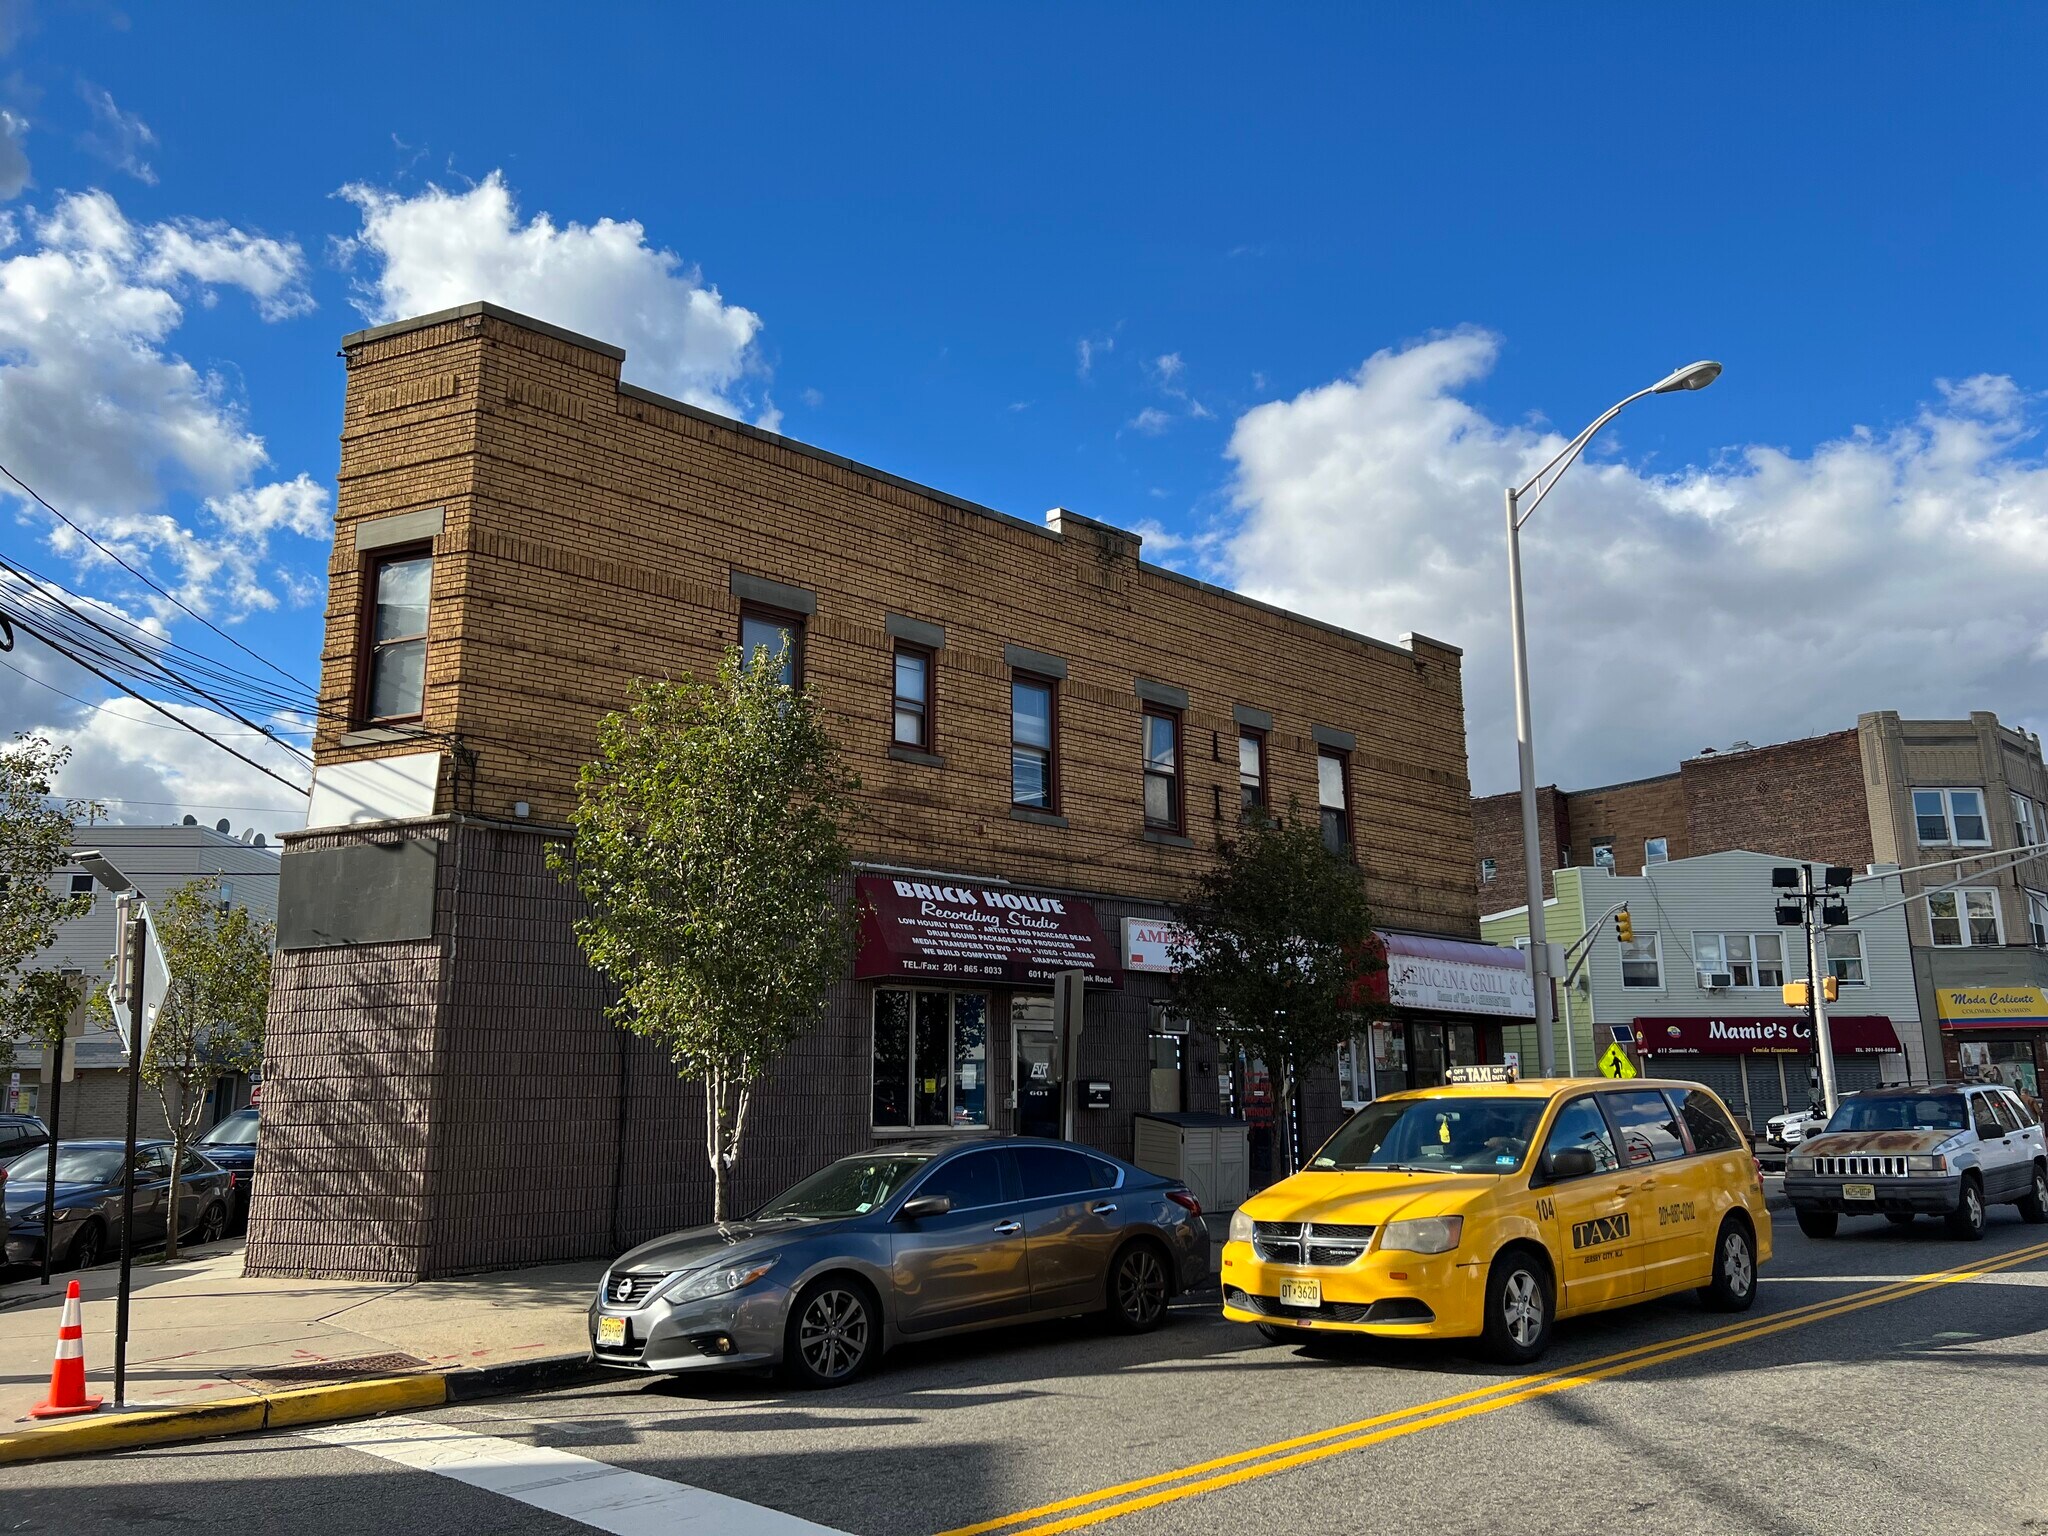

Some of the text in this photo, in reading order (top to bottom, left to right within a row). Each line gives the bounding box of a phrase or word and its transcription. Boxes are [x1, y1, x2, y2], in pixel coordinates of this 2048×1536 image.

[893, 880, 1067, 915] BRICK HOUSE
[921, 901, 1060, 930] Recording Studio
[897, 917, 915, 925] LOW
[916, 919, 948, 929] HOURLY
[949, 922, 974, 931] RATES
[983, 926, 1009, 934] ARTIST
[1010, 928, 1031, 937] DEMO
[1069, 934, 1092, 942] DEALS
[926, 929, 950, 938] DRUM
[950, 932, 978, 940] SOUND
[978, 934, 1018, 944] PACKAGES
[1033, 940, 1076, 949] PRODUCERS
[911, 937, 938, 946] MEDIA
[938, 940, 984, 950] TRANSFERS
[1015, 946, 1032, 954] VHS
[1035, 948, 1058, 956] VIDEO
[1062, 951, 1096, 960] CAMERAS
[922, 947, 1008, 961] WE BUILD COMPUTERS
[943, 963, 957, 972] 201
[963, 965, 978, 973] 865
[983, 966, 1003, 975] 8033
[1031, 956, 1095, 968] GRAPHIC DESIGNS
[1028, 970, 1041, 978] 601
[1469, 972, 1507, 995] GRILL
[1509, 976, 1518, 996] &
[1951, 993, 2034, 1006] Moda Caliente
[1708, 1020, 1788, 1039] Mamie's
[1465, 1067, 1492, 1082] TAXI
[1535, 1198, 1555, 1222] 104
[1574, 1213, 1629, 1248] TAXI
[1584, 1252, 1601, 1265] JERSEY
